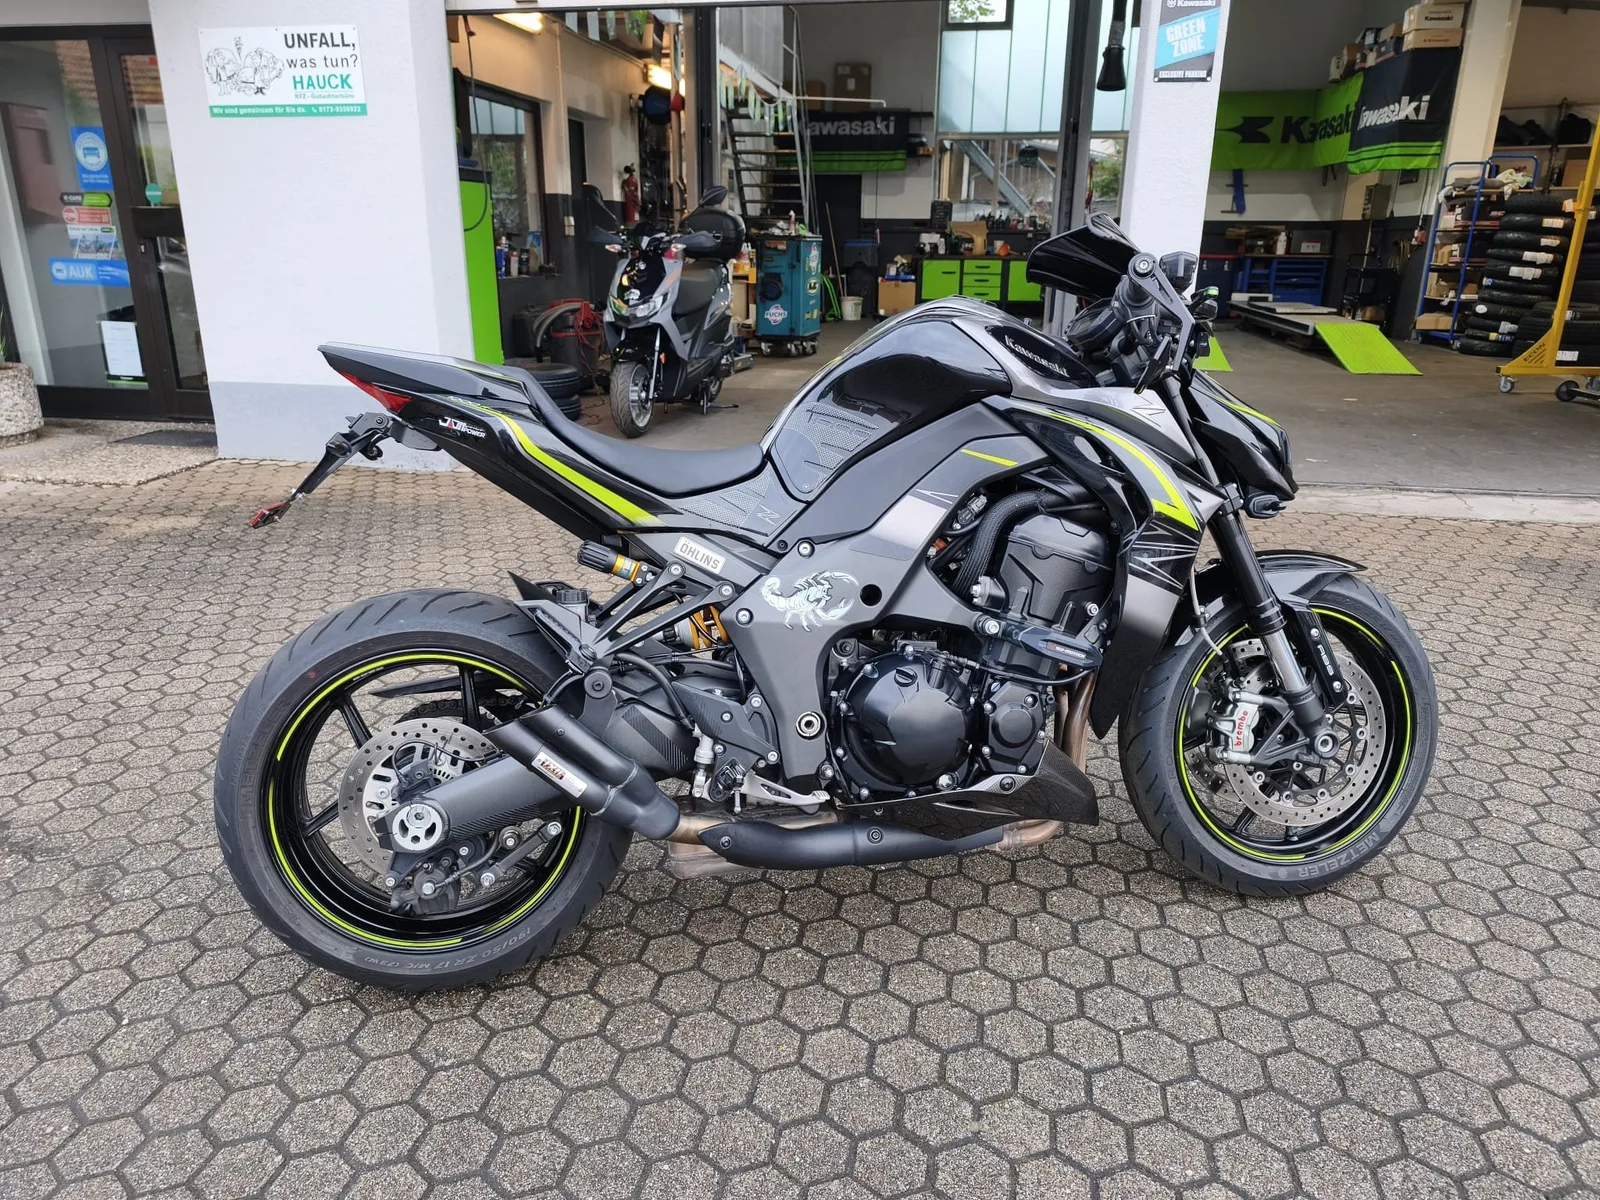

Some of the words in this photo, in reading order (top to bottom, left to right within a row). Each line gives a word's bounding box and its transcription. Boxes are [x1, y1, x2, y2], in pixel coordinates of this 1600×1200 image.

[1165, 16, 1206, 43] GREEN
[284, 32, 356, 51] UNFALL,
[1171, 33, 1205, 58] ZONE
[286, 57, 317, 68] was
[323, 53, 358, 68] tun?
[292, 73, 353, 90] HAUCK
[800, 116, 896, 136] awasaki
[69, 265, 93, 277] AUK
[1004, 334, 1070, 378] Kawasaki
[679, 540, 721, 570] ÖHLINS
[1316, 644, 1335, 676] ABS
[1233, 710, 1249, 747] brembo
[1298, 831, 1380, 877] METZELER
[433, 961, 450, 970] 17
[454, 954, 477, 967] ZR
